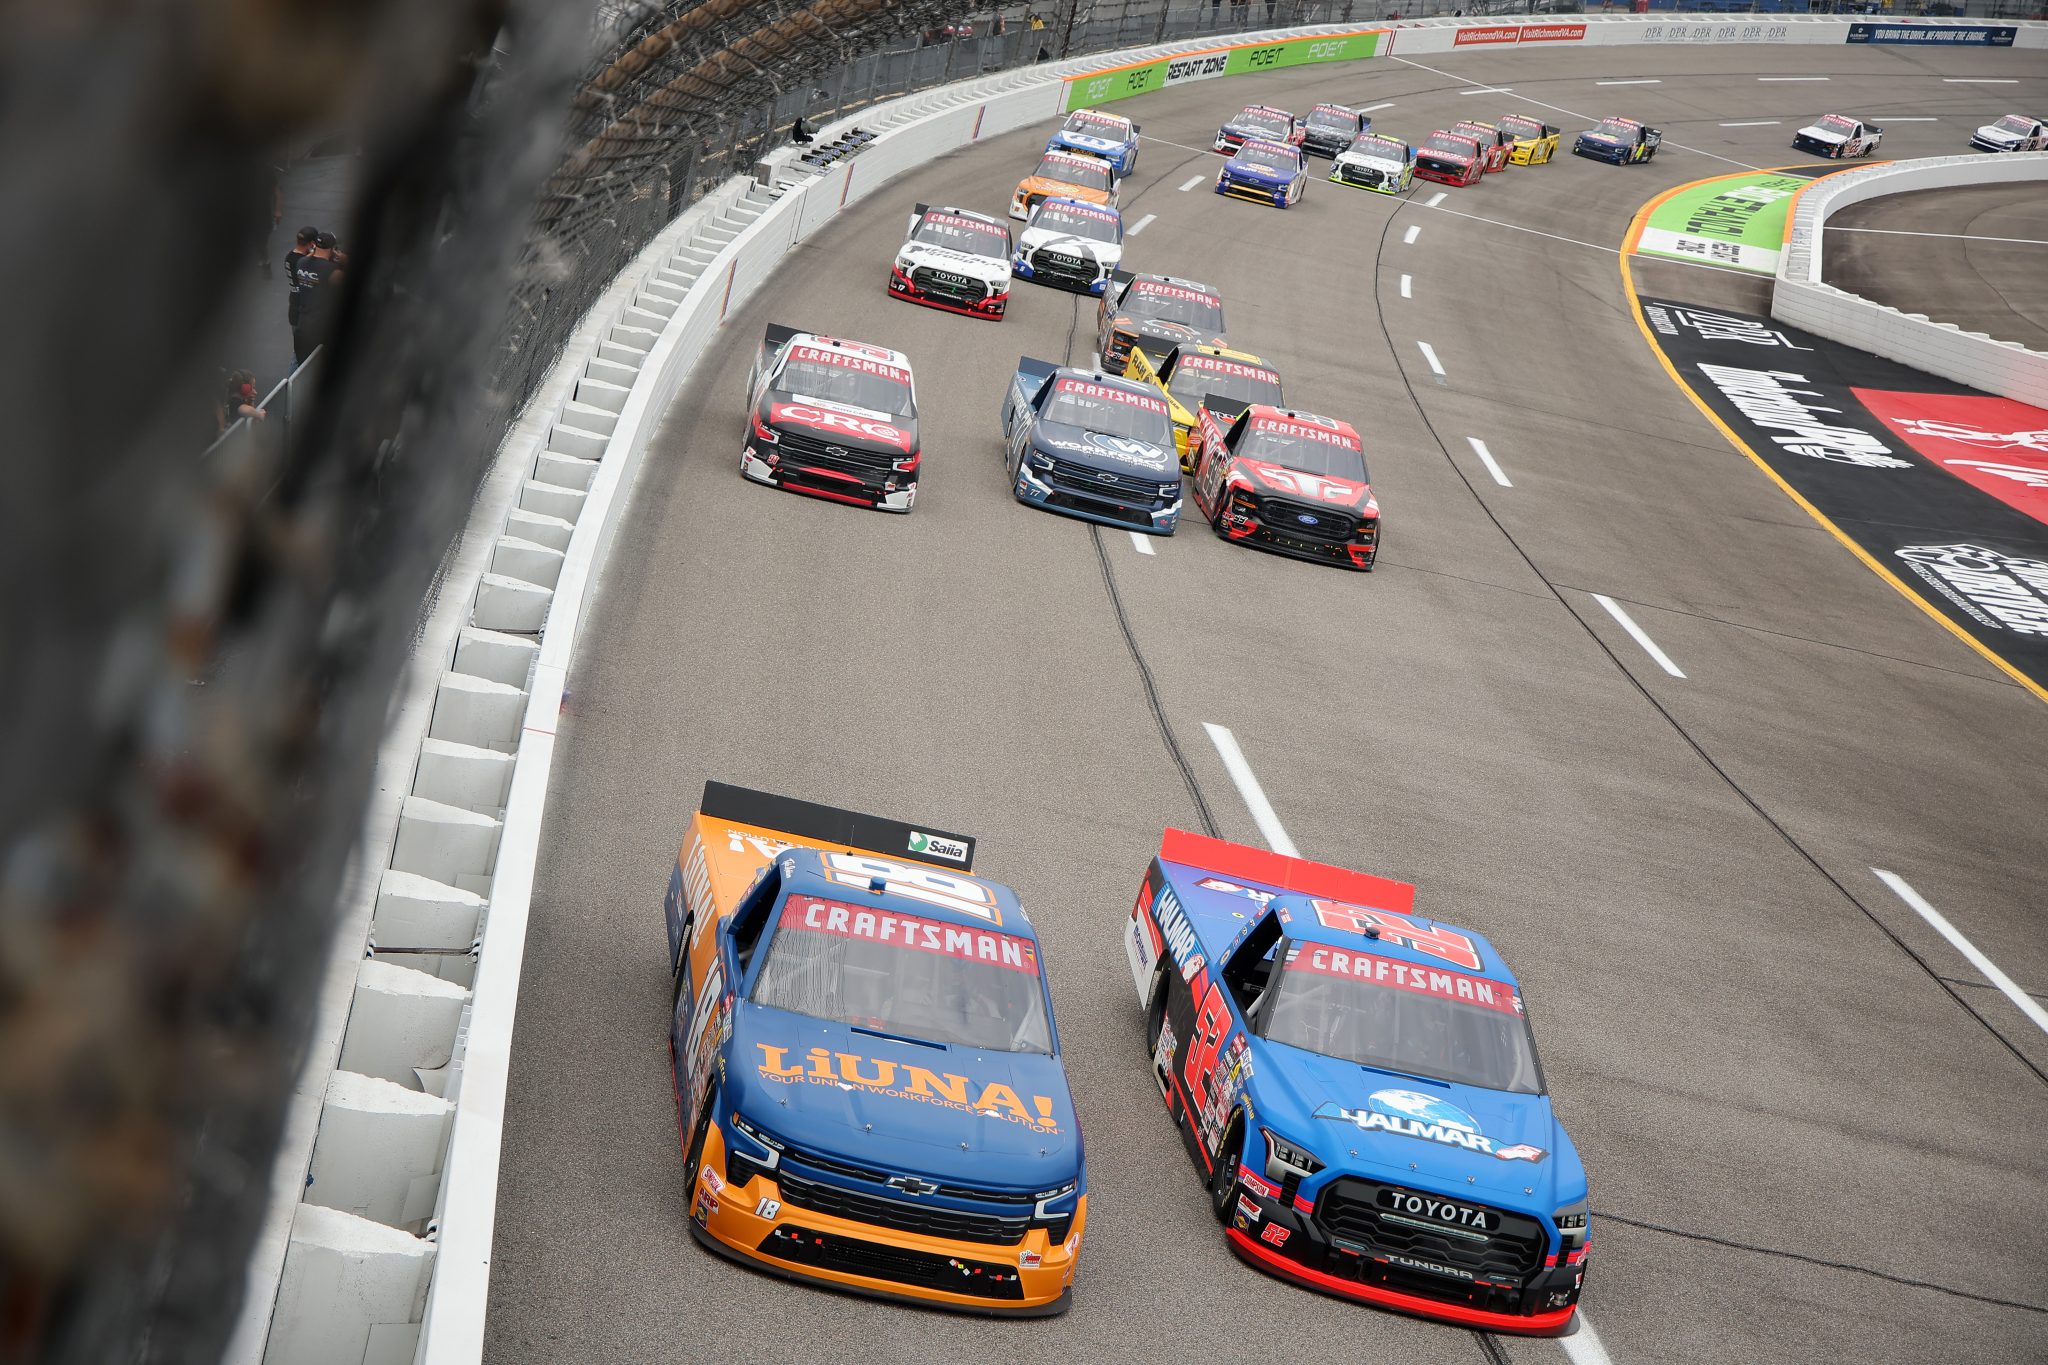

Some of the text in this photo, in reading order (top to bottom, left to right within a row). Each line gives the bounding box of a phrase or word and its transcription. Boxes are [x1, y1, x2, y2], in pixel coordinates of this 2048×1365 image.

[1456, 29, 1517, 42] VisitRichmondVA.com
[1522, 27, 1583, 40] VisitRichmondVA.com
[1249, 47, 1284, 67] POET
[1308, 40, 1348, 58] POET
[1126, 69, 1152, 91] POET
[1168, 55, 1228, 80] RESTART ZONE
[1086, 78, 1113, 100] POET
[1073, 112, 1128, 130] CRAFTSMAN
[1249, 141, 1297, 158] CRAFTSMAN
[1047, 155, 1105, 173] CRAFTSMAN
[929, 212, 1003, 237] CRAFTSMAN
[1047, 201, 1114, 223] CRAFTSMAN
[1052, 252, 1082, 266] TOYOTA
[934, 270, 969, 286] TOYOTA
[1138, 281, 1213, 306] CRAFTSMAN
[797, 346, 900, 380] CRAFTSMAN
[1183, 355, 1276, 386] CRAFTSMAN
[1064, 380, 1161, 412] CRAFTSMAN
[780, 405, 901, 443] CRC
[1257, 418, 1352, 448] CRAFTSMAN
[928, 839, 964, 859] Saiia
[804, 902, 1022, 968] CRAFTSMAN
[1312, 948, 1494, 1005] CRAFTSMAN
[756, 1042, 1058, 1128] LiUNA!
[758, 1070, 1060, 1136] YOUR UNIN WORKFORCE SLUTION
[1340, 1107, 1494, 1154] HALMAR
[1244, 1174, 1267, 1196] SIMPSON
[755, 1197, 781, 1220] 18
[1391, 1191, 1488, 1230] TOYOTA
[1261, 1222, 1291, 1247] 52
[1385, 1253, 1474, 1280] TUNDRA
